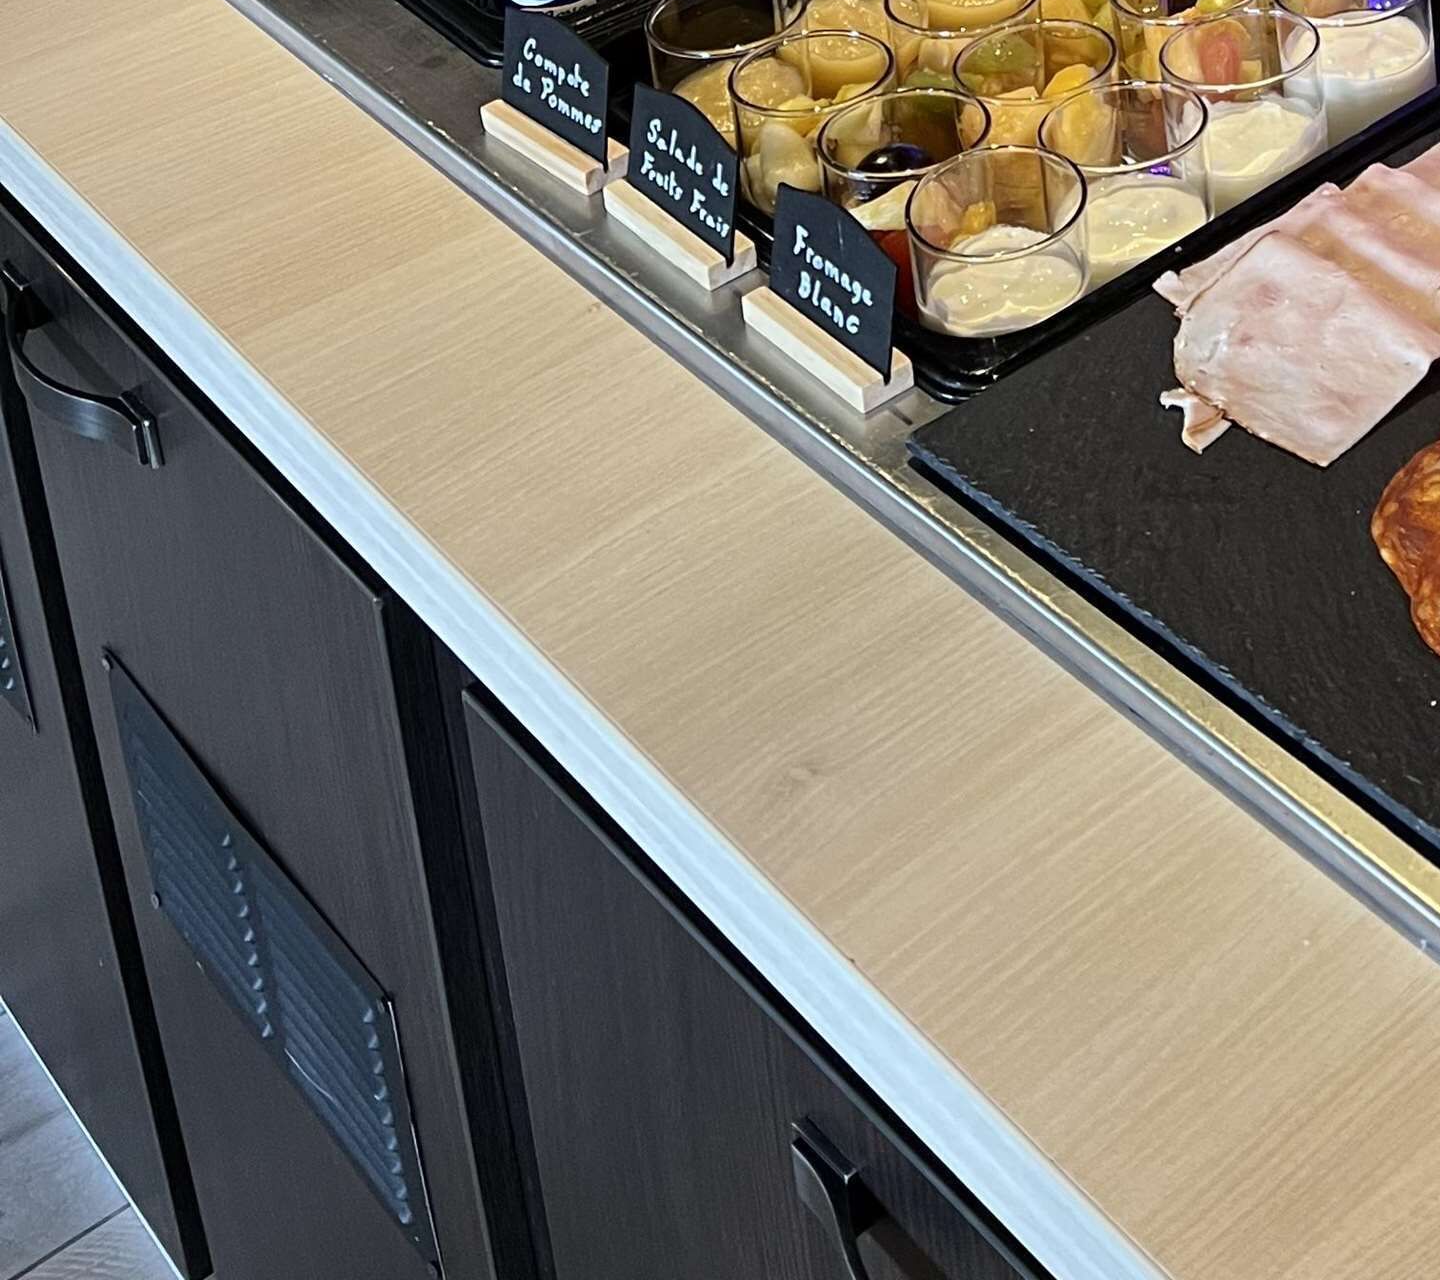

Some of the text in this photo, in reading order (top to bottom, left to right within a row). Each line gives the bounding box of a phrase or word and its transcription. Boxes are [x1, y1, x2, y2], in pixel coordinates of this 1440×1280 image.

[512, 63, 603, 135] de Pommes
[523, 38, 590, 98] Compote
[639, 150, 730, 239] Fruits Frais
[647, 118, 730, 198] Salade de
[792, 225, 873, 307] Fromage
[797, 272, 860, 335] Blanc
